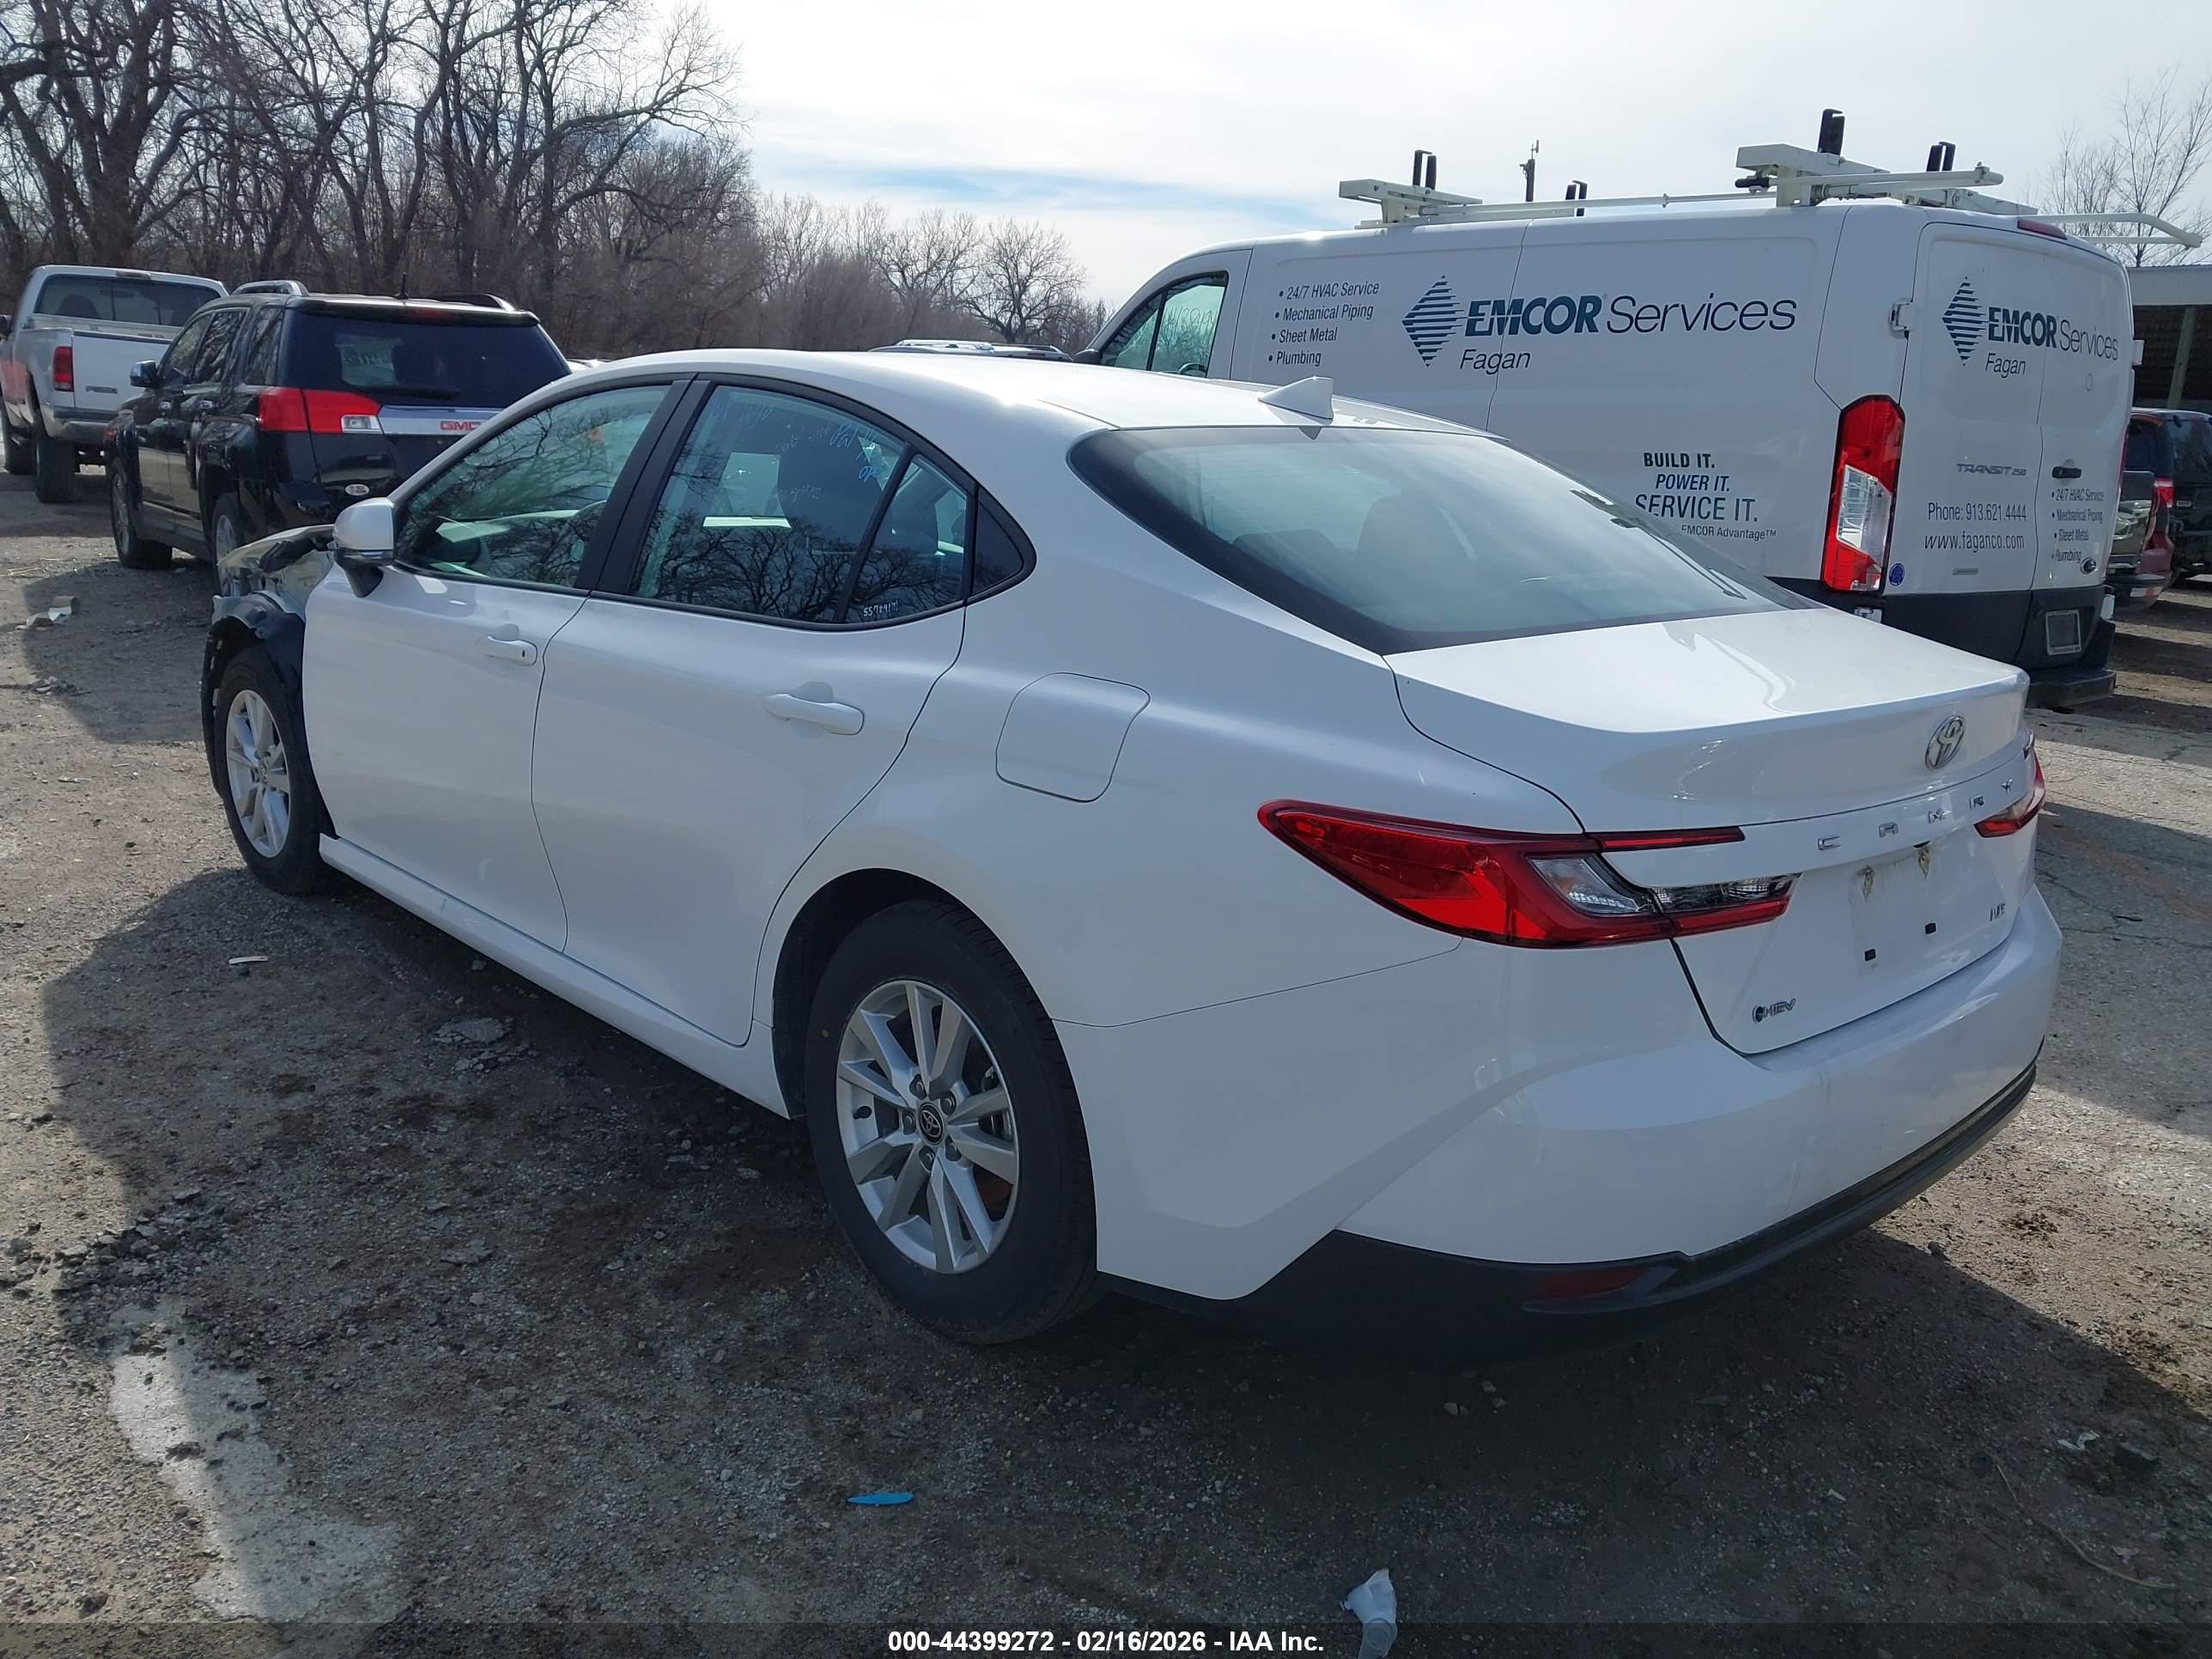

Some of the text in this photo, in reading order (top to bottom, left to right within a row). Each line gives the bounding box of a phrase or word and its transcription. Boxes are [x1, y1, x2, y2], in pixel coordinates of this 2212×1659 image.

[1286, 281, 1380, 300] 24/7 HVAC Service
[1283, 303, 1374, 321] Mechanical Piping
[1464, 292, 1798, 337] EMCOR Services
[1279, 326, 1338, 343] Sheet Metal
[1988, 307, 2118, 361] EMCOR Services
[1276, 350, 1322, 368] Plumbing
[1460, 349, 1531, 375] Fagan
[1985, 352, 2027, 379] Fagan
[439, 421, 481, 431] GMC
[1643, 453, 1716, 469] BUILD IT.
[1956, 464, 2012, 475] TRANSIT
[1655, 474, 1730, 492] POWER IT.
[1635, 494, 1758, 522] SERVICE IT.
[1928, 501, 2027, 522] Phone: 913.621.4444
[1924, 530, 2025, 553] www.faganco.com
